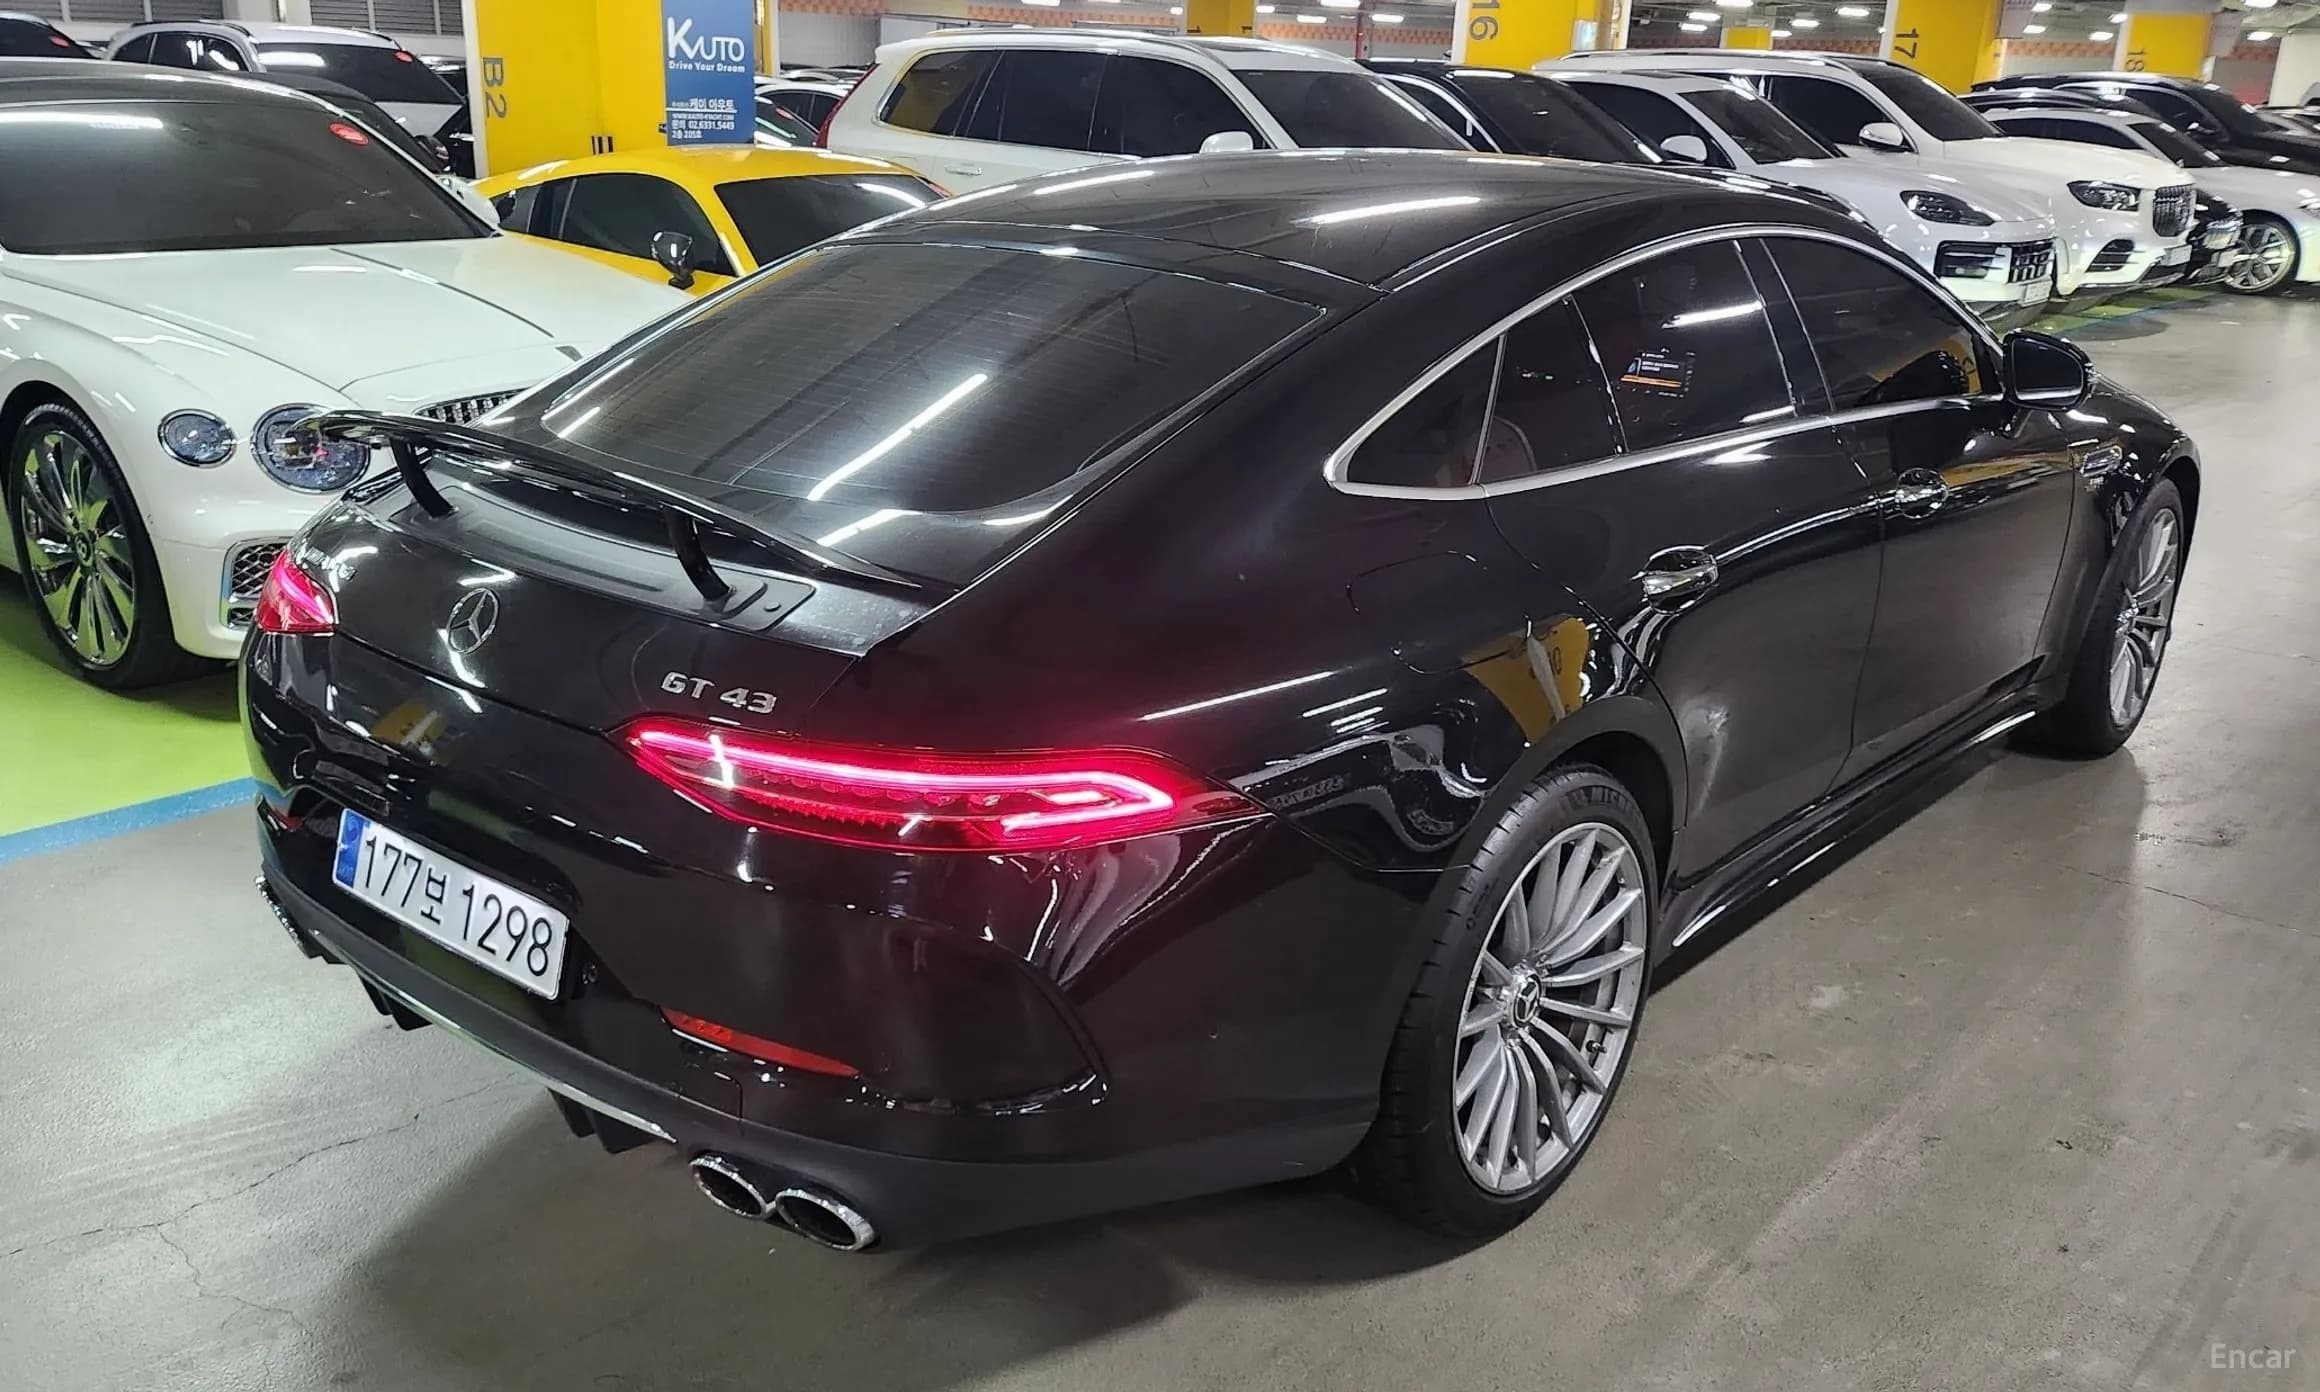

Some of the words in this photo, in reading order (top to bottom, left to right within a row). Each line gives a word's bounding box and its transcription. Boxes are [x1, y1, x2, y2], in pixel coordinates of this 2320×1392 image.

[1469, 0, 1500, 41] 16
[1894, 28, 1919, 59] 17
[2125, 48, 2146, 72] 18
[668, 60, 693, 71] Drive
[694, 62, 715, 72] Your
[716, 63, 746, 73] Dream
[482, 57, 507, 118] B2
[661, 671, 716, 699] GT
[720, 687, 777, 714] 43
[366, 835, 447, 925] 177보
[462, 884, 553, 977] 1298
